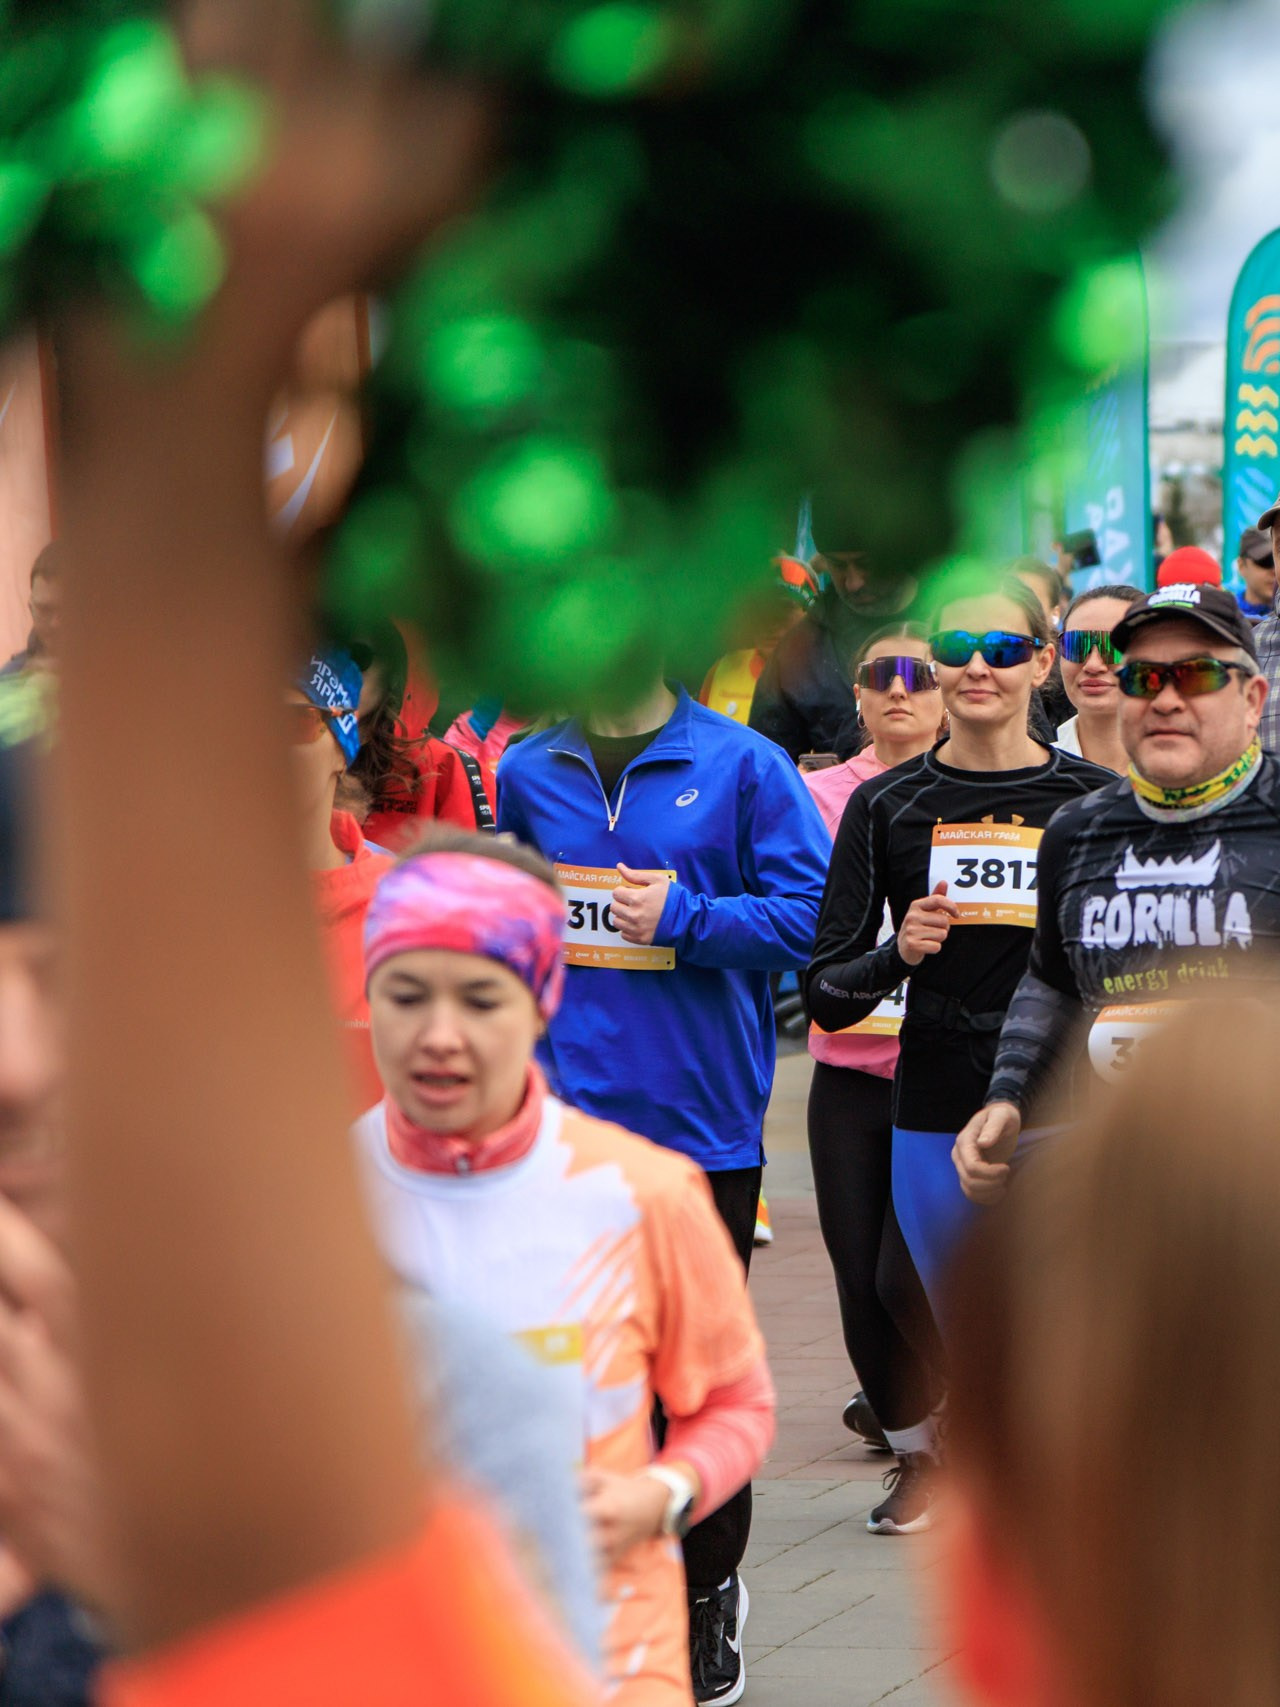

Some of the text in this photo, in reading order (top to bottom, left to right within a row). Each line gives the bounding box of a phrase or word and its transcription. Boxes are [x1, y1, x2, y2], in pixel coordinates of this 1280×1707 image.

[954, 858, 1039, 890] 3817
[1081, 890, 1254, 951] GORILLA
[1103, 957, 1229, 994] energy drink
